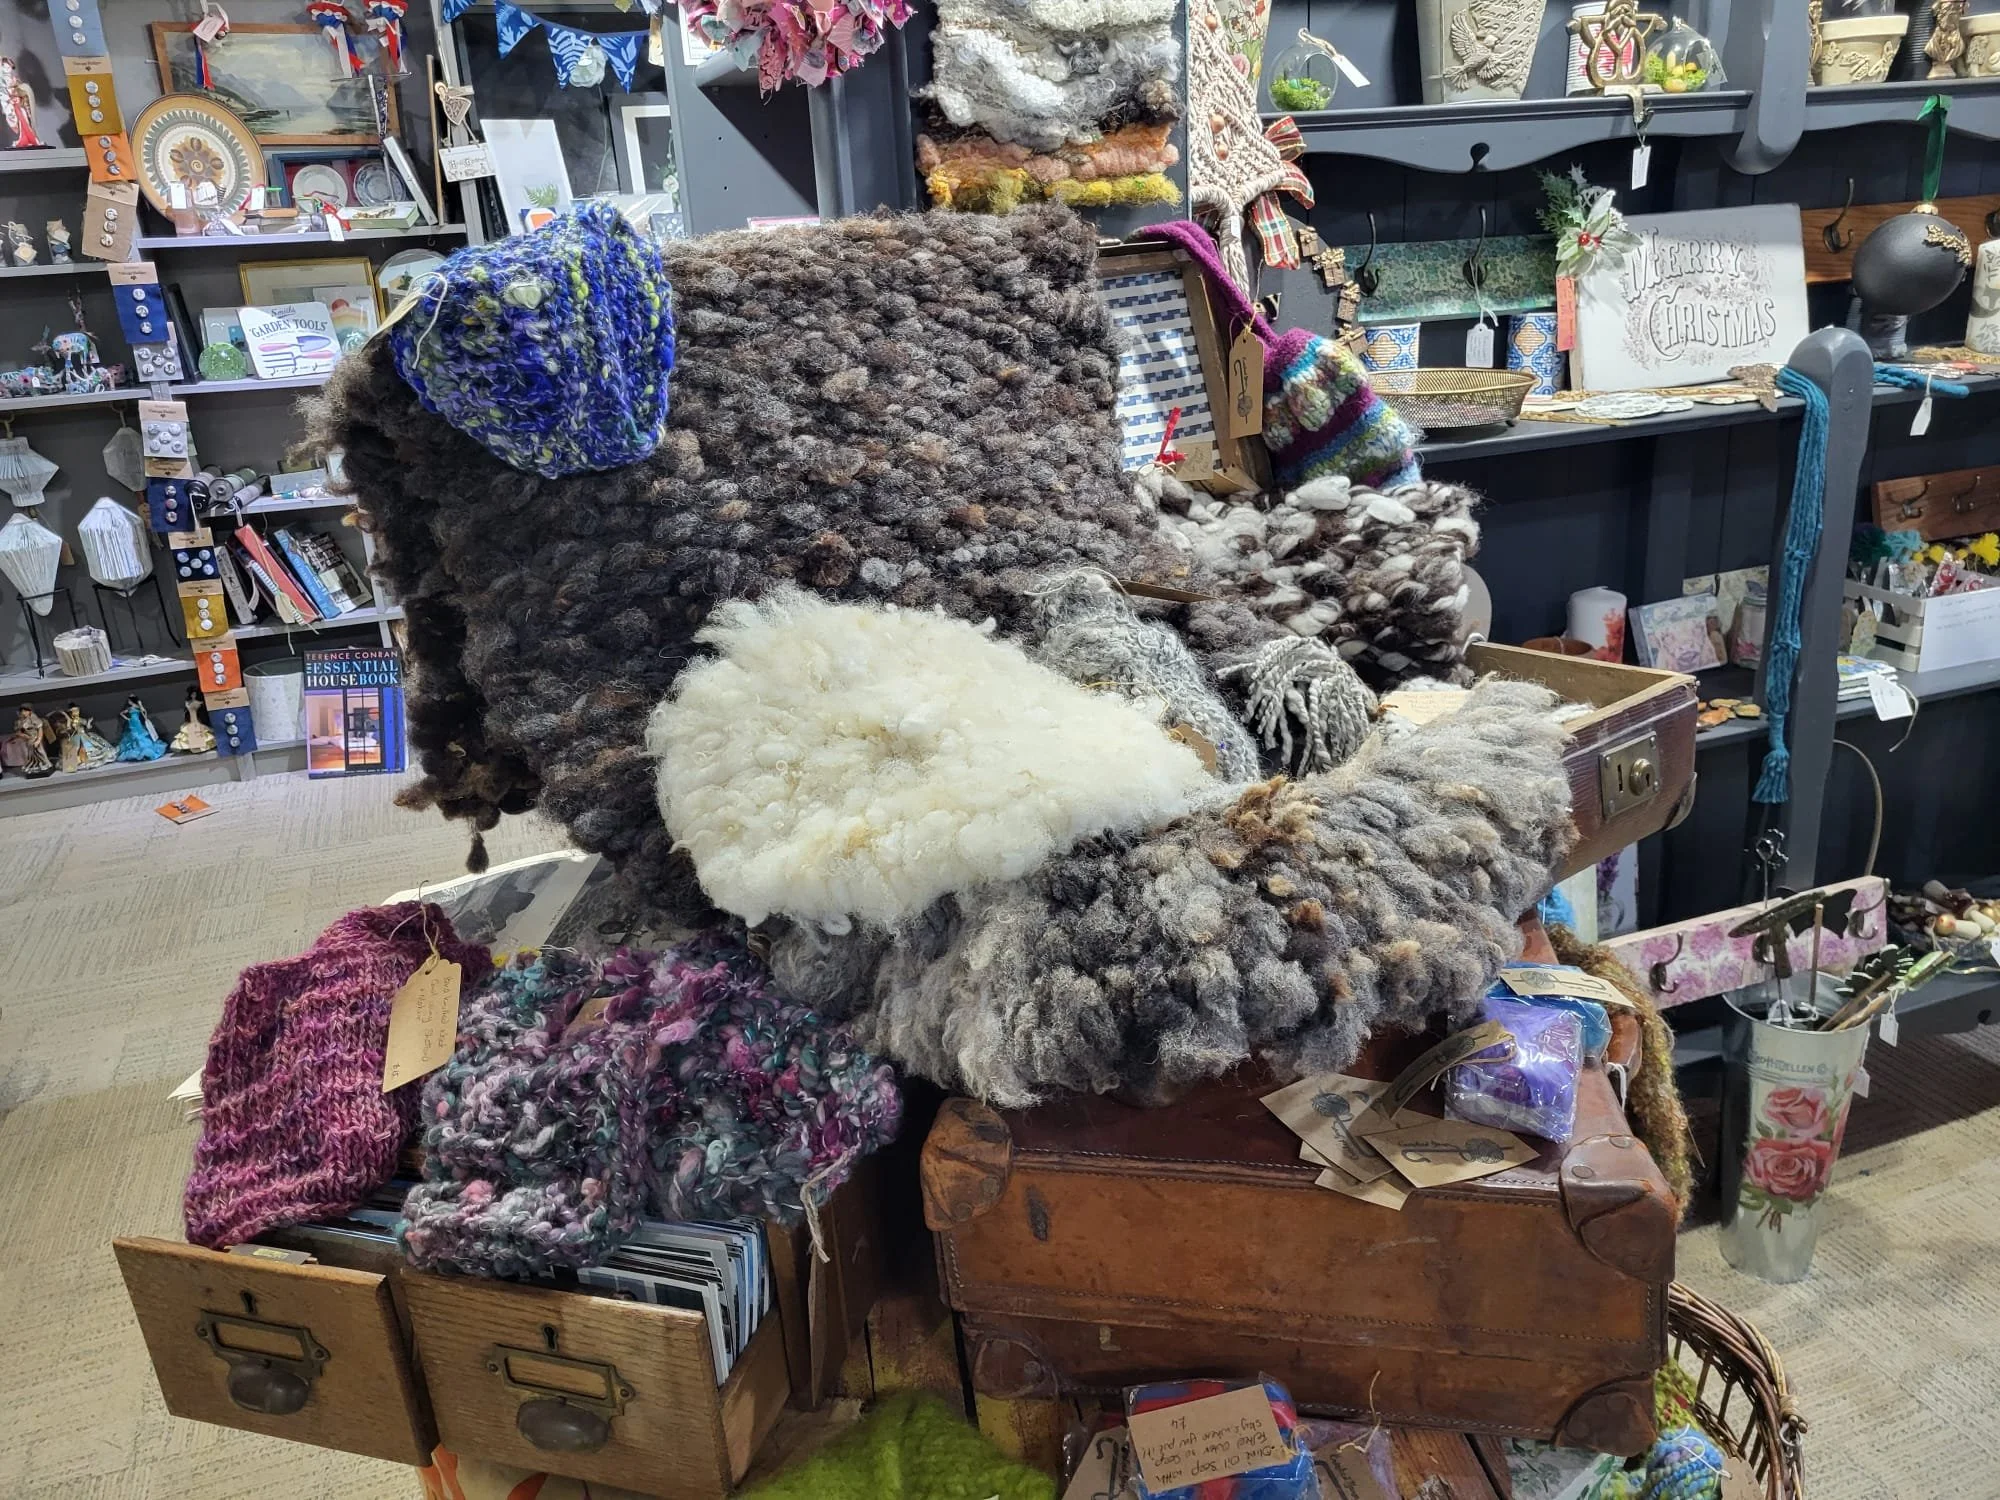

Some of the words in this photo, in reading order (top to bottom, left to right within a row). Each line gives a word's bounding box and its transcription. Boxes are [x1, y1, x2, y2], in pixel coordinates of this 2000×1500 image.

[1626, 227, 1743, 303] MERRY
[1649, 284, 1776, 361] CHRISTMAS
[306, 652, 351, 661] TERENCE
[354, 650, 399, 660] CONRAN
[312, 660, 399, 674] ESSENTIAL
